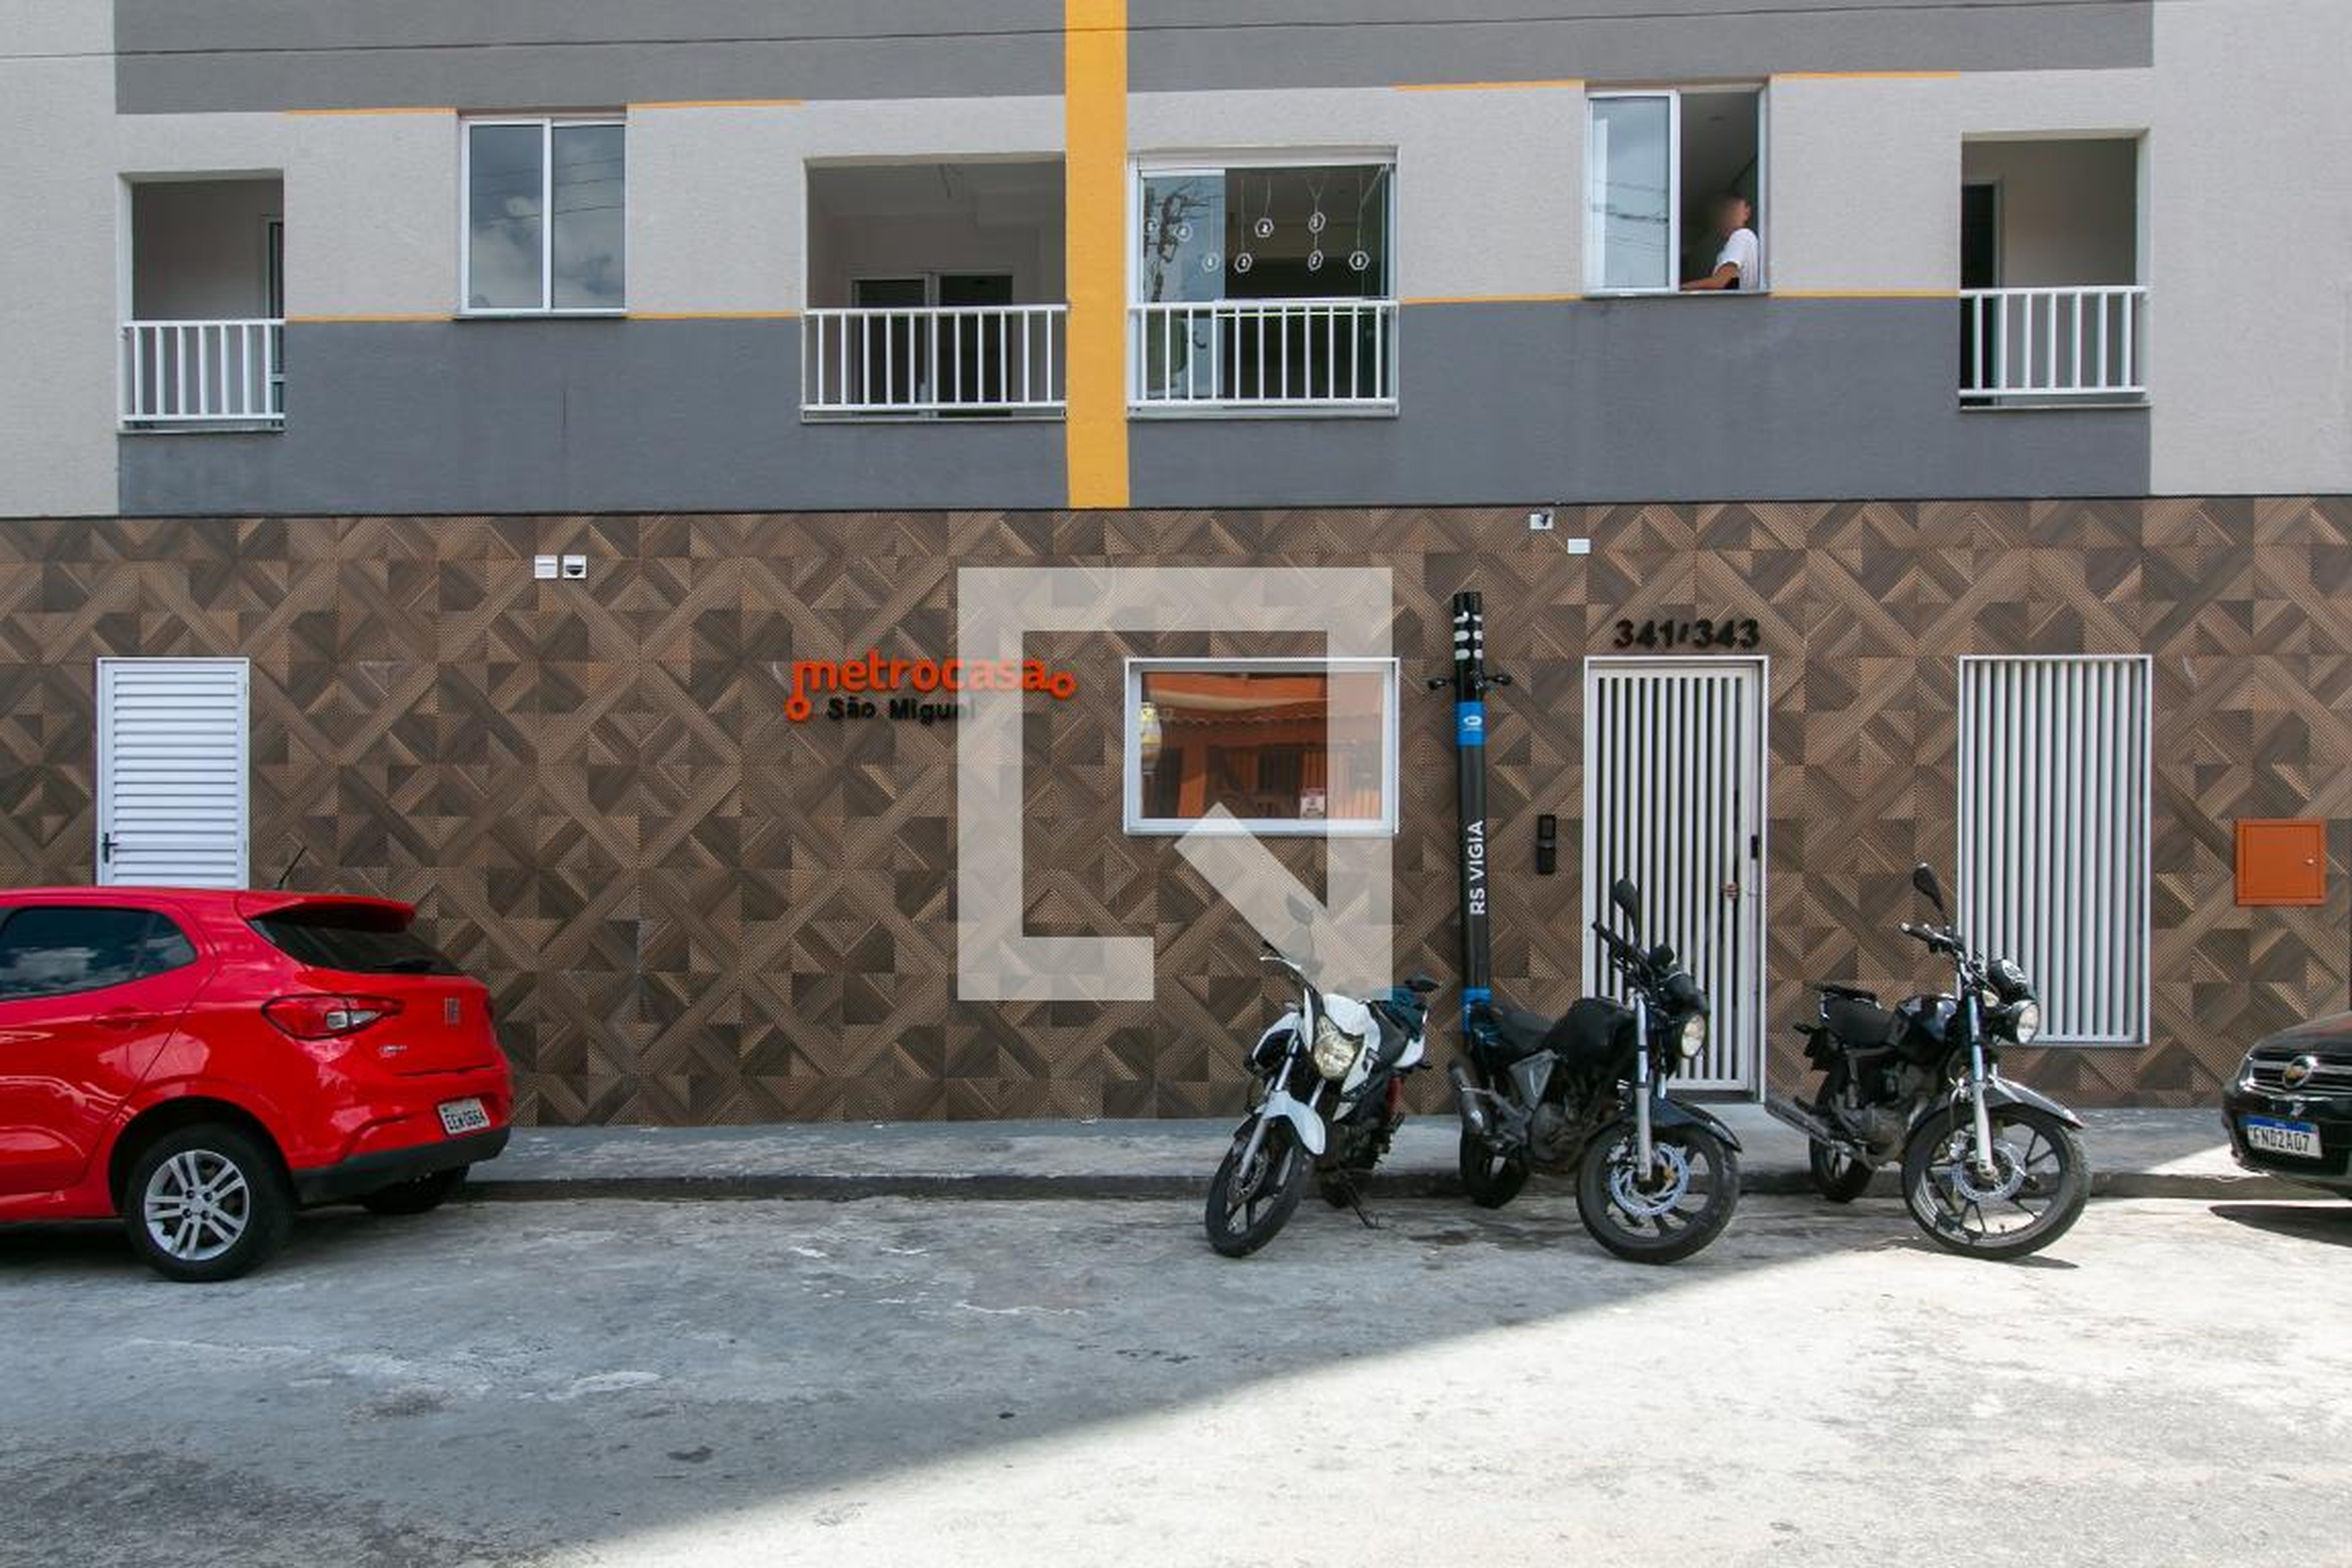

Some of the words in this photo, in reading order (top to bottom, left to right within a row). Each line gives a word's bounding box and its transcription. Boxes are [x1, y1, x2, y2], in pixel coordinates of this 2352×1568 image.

[1613, 618, 1761, 649] 341/343
[791, 647, 1060, 701] metrocasa
[828, 696, 876, 720] São
[1467, 820, 1485, 881] VIGIA
[1469, 887, 1487, 915] RS
